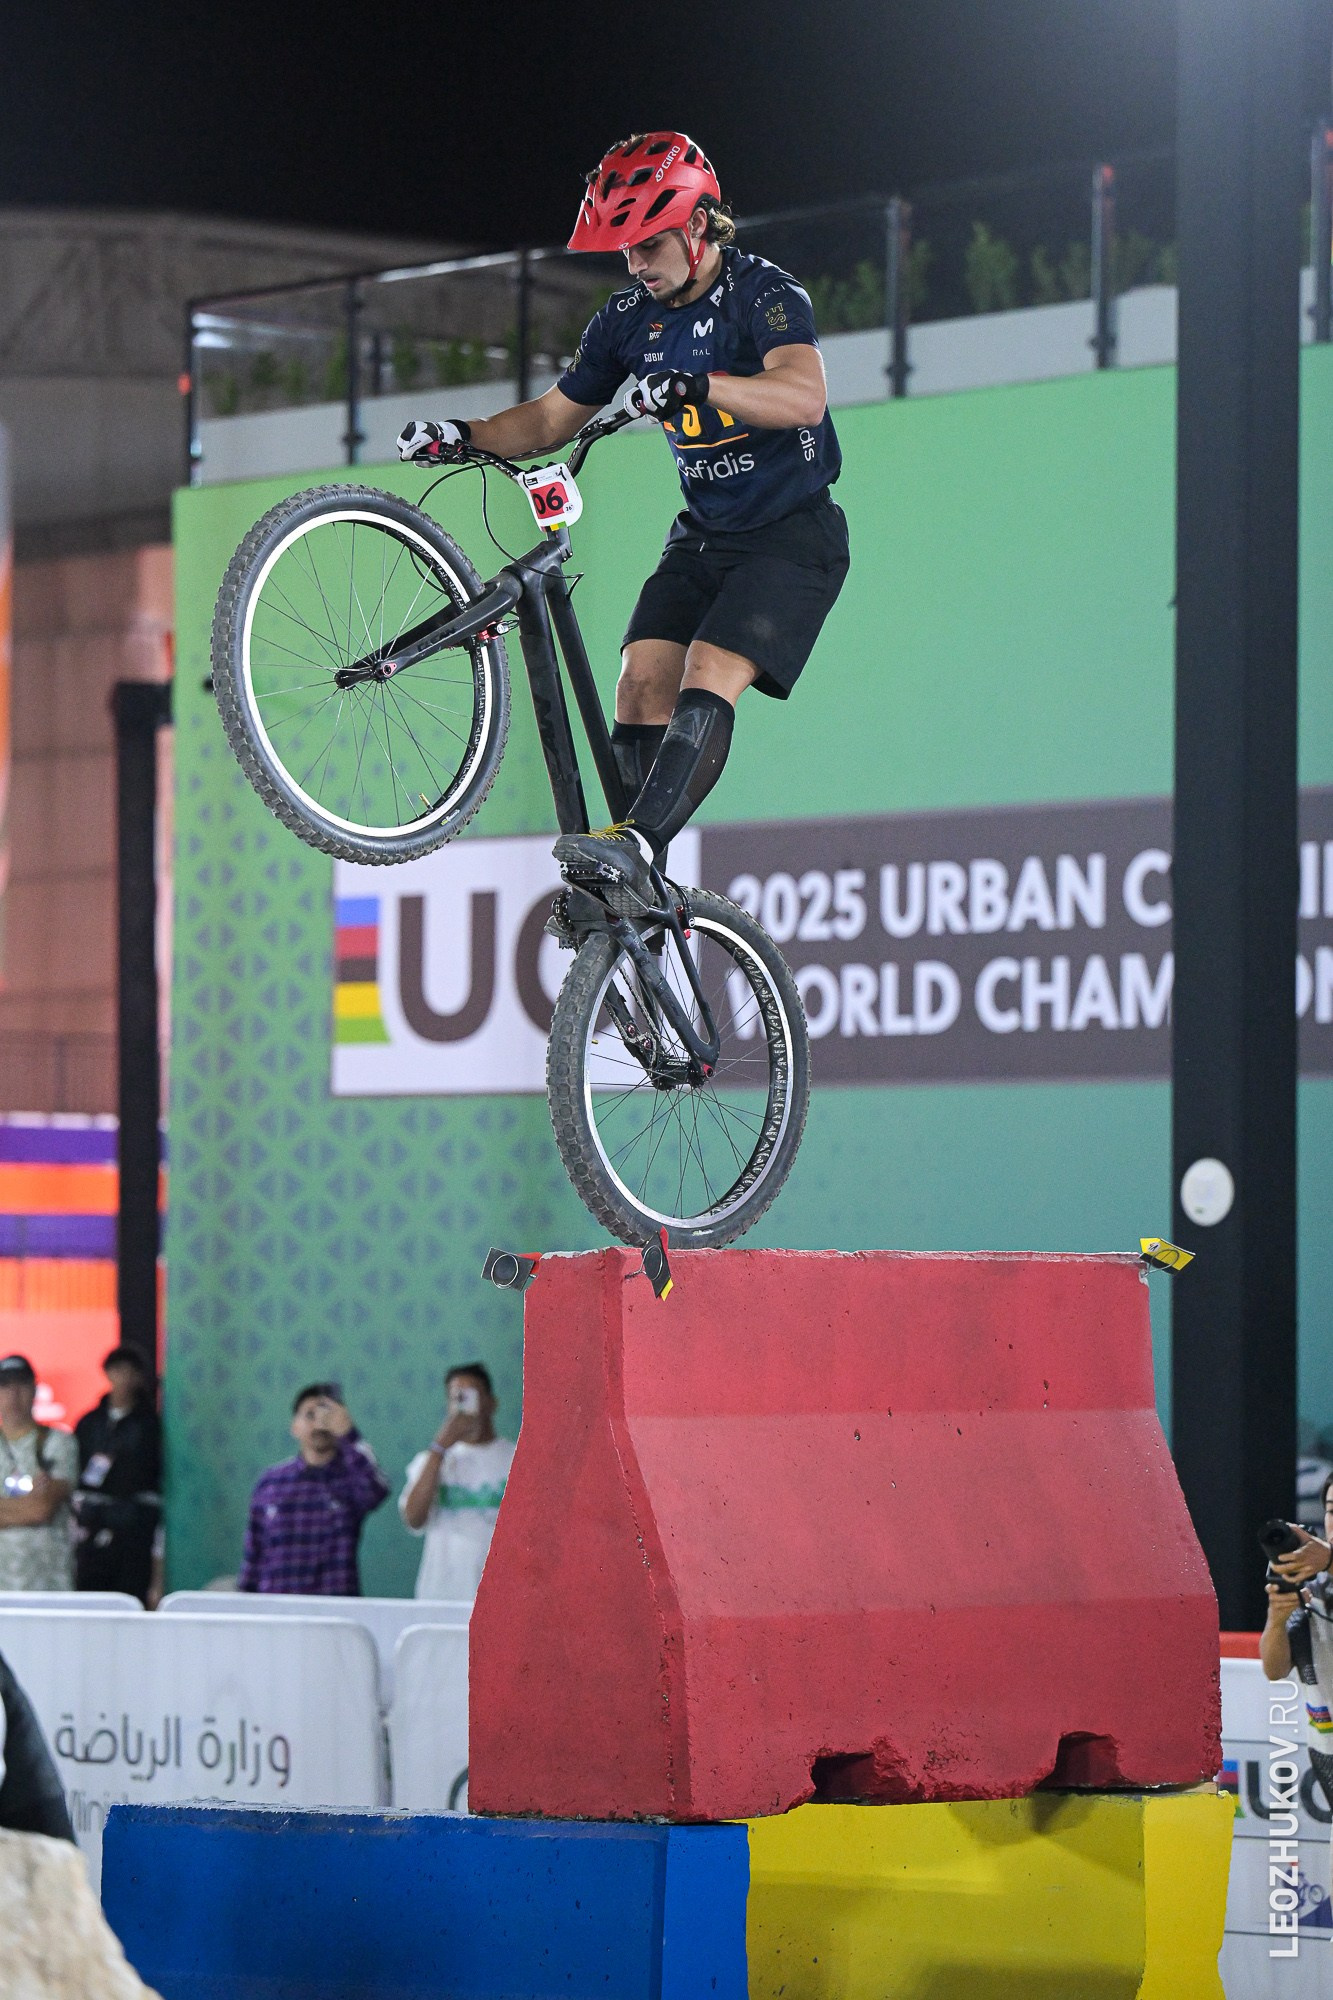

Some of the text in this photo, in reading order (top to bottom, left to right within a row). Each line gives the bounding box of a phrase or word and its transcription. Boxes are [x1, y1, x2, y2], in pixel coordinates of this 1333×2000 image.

[661, 145, 681, 170] GIRO
[727, 867, 867, 944] 2025
[879, 852, 1107, 938] URBAN
[54, 1712, 293, 1788] وزارة الرياضة
